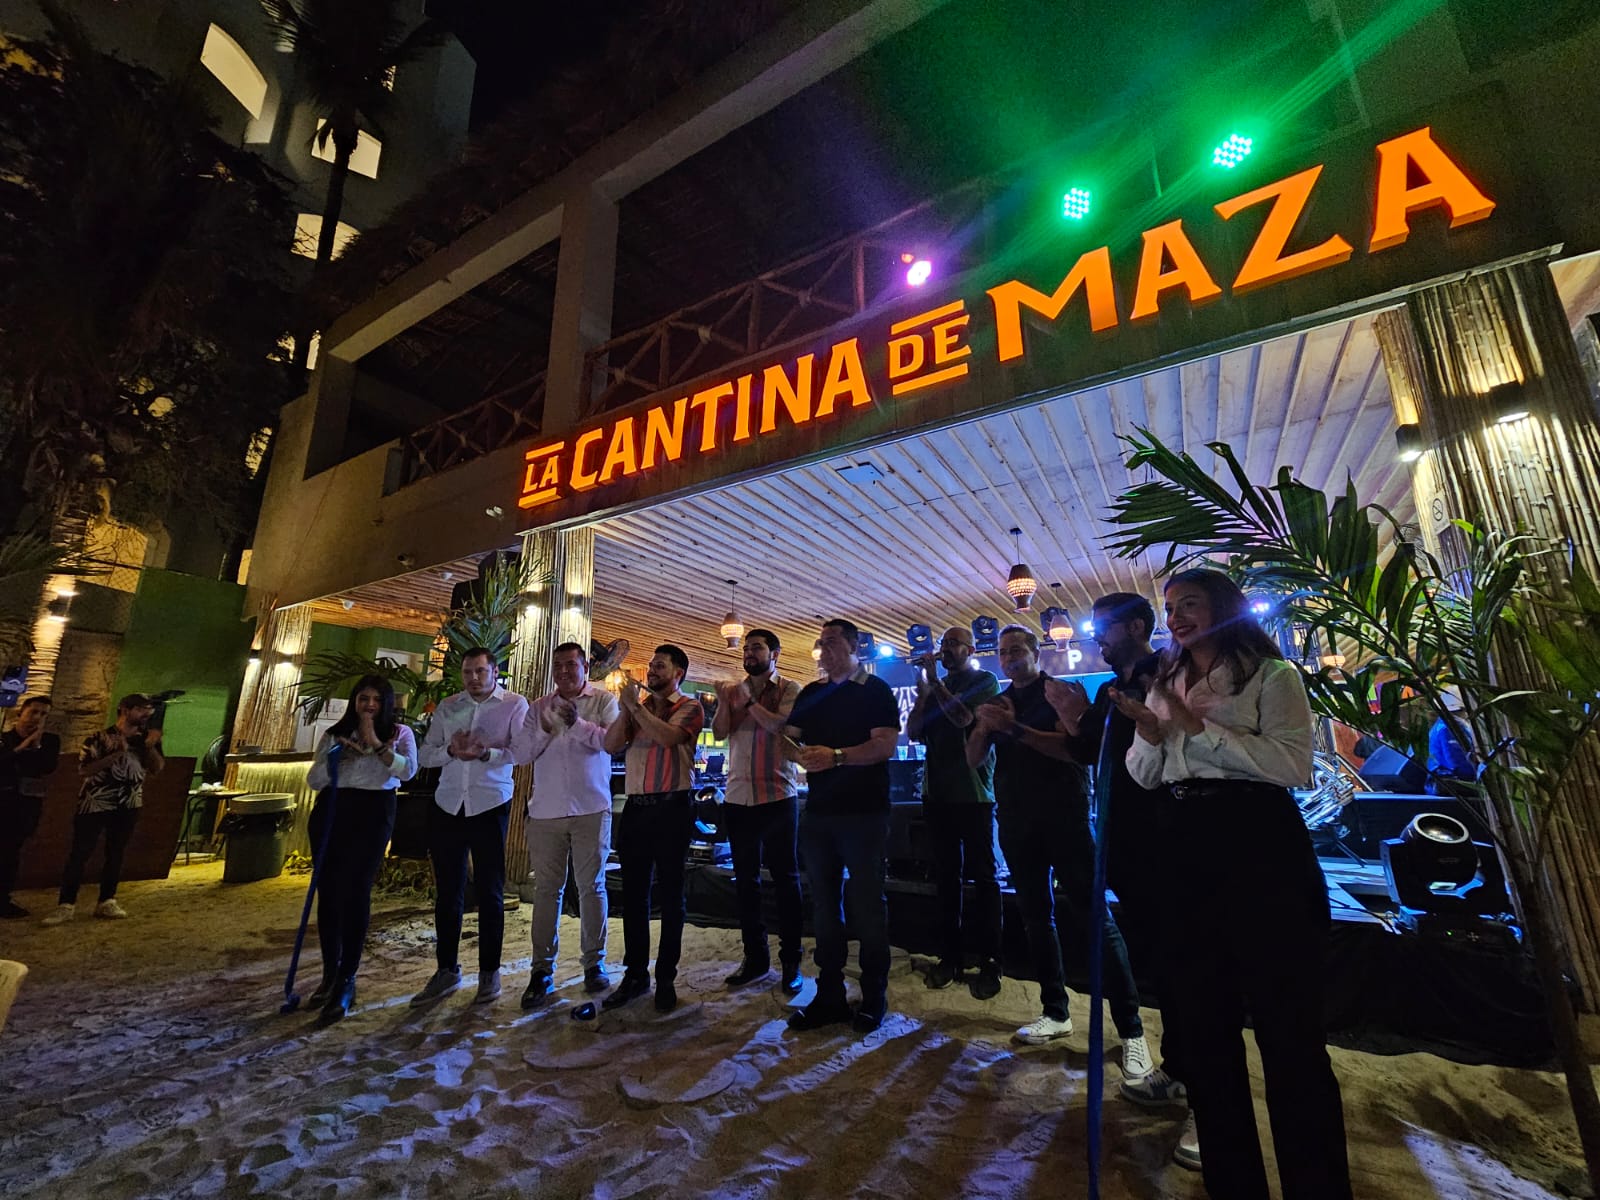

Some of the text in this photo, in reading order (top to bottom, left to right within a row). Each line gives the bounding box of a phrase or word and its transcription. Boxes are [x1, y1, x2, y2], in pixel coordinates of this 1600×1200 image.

[522, 127, 1496, 494] LA CANTINA DE MAZA
